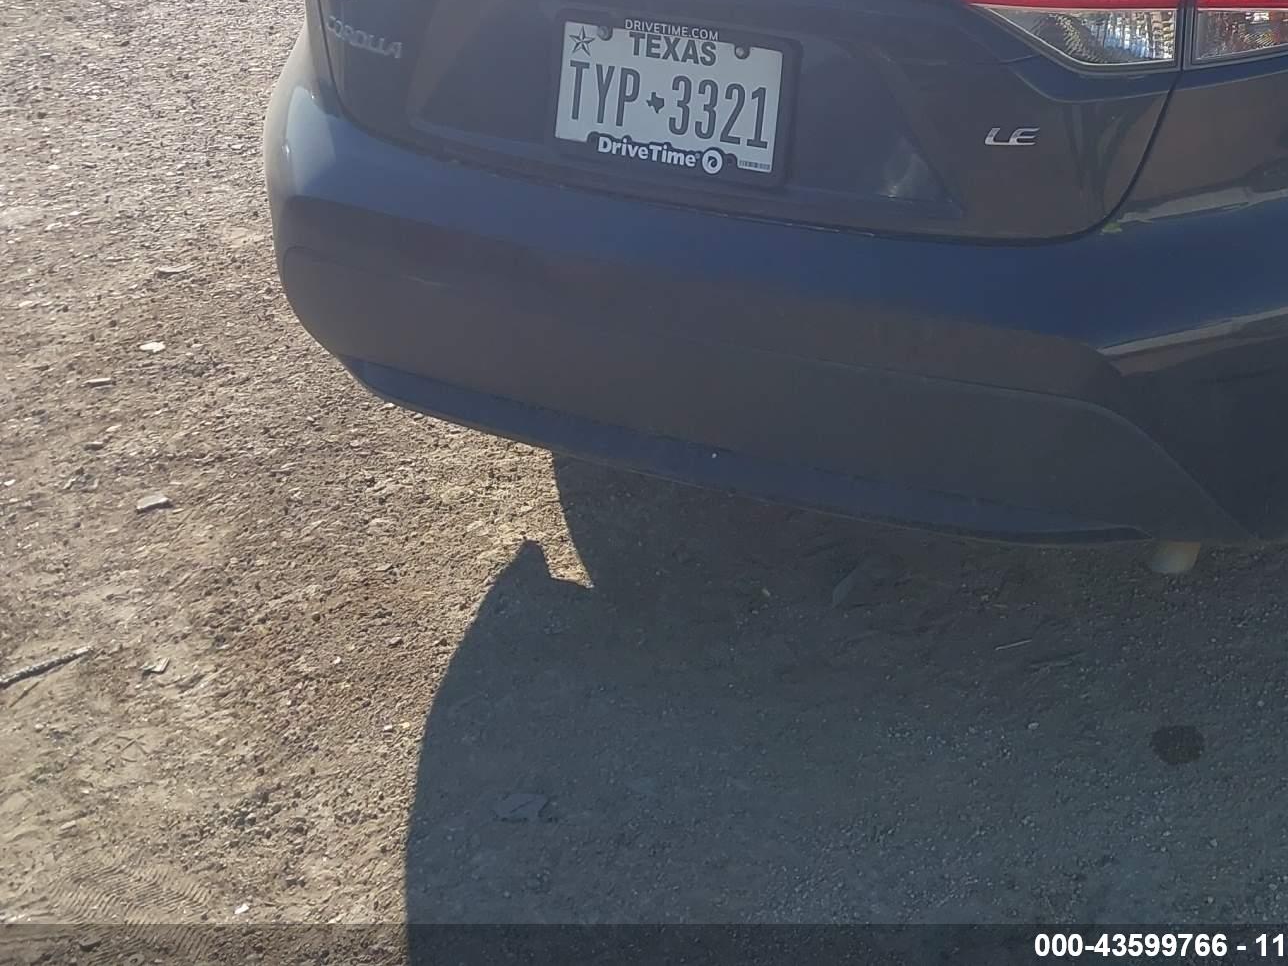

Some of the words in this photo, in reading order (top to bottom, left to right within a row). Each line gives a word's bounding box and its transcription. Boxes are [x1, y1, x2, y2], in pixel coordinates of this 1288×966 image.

[326, 16, 403, 59] COROLLA
[624, 18, 719, 41] DRIVETIME.COM
[628, 31, 717, 67] TEXAS
[569, 59, 641, 127] TYP
[668, 75, 769, 149] 3321
[597, 136, 697, 168] DriveTime
[984, 127, 1040, 146] LE
